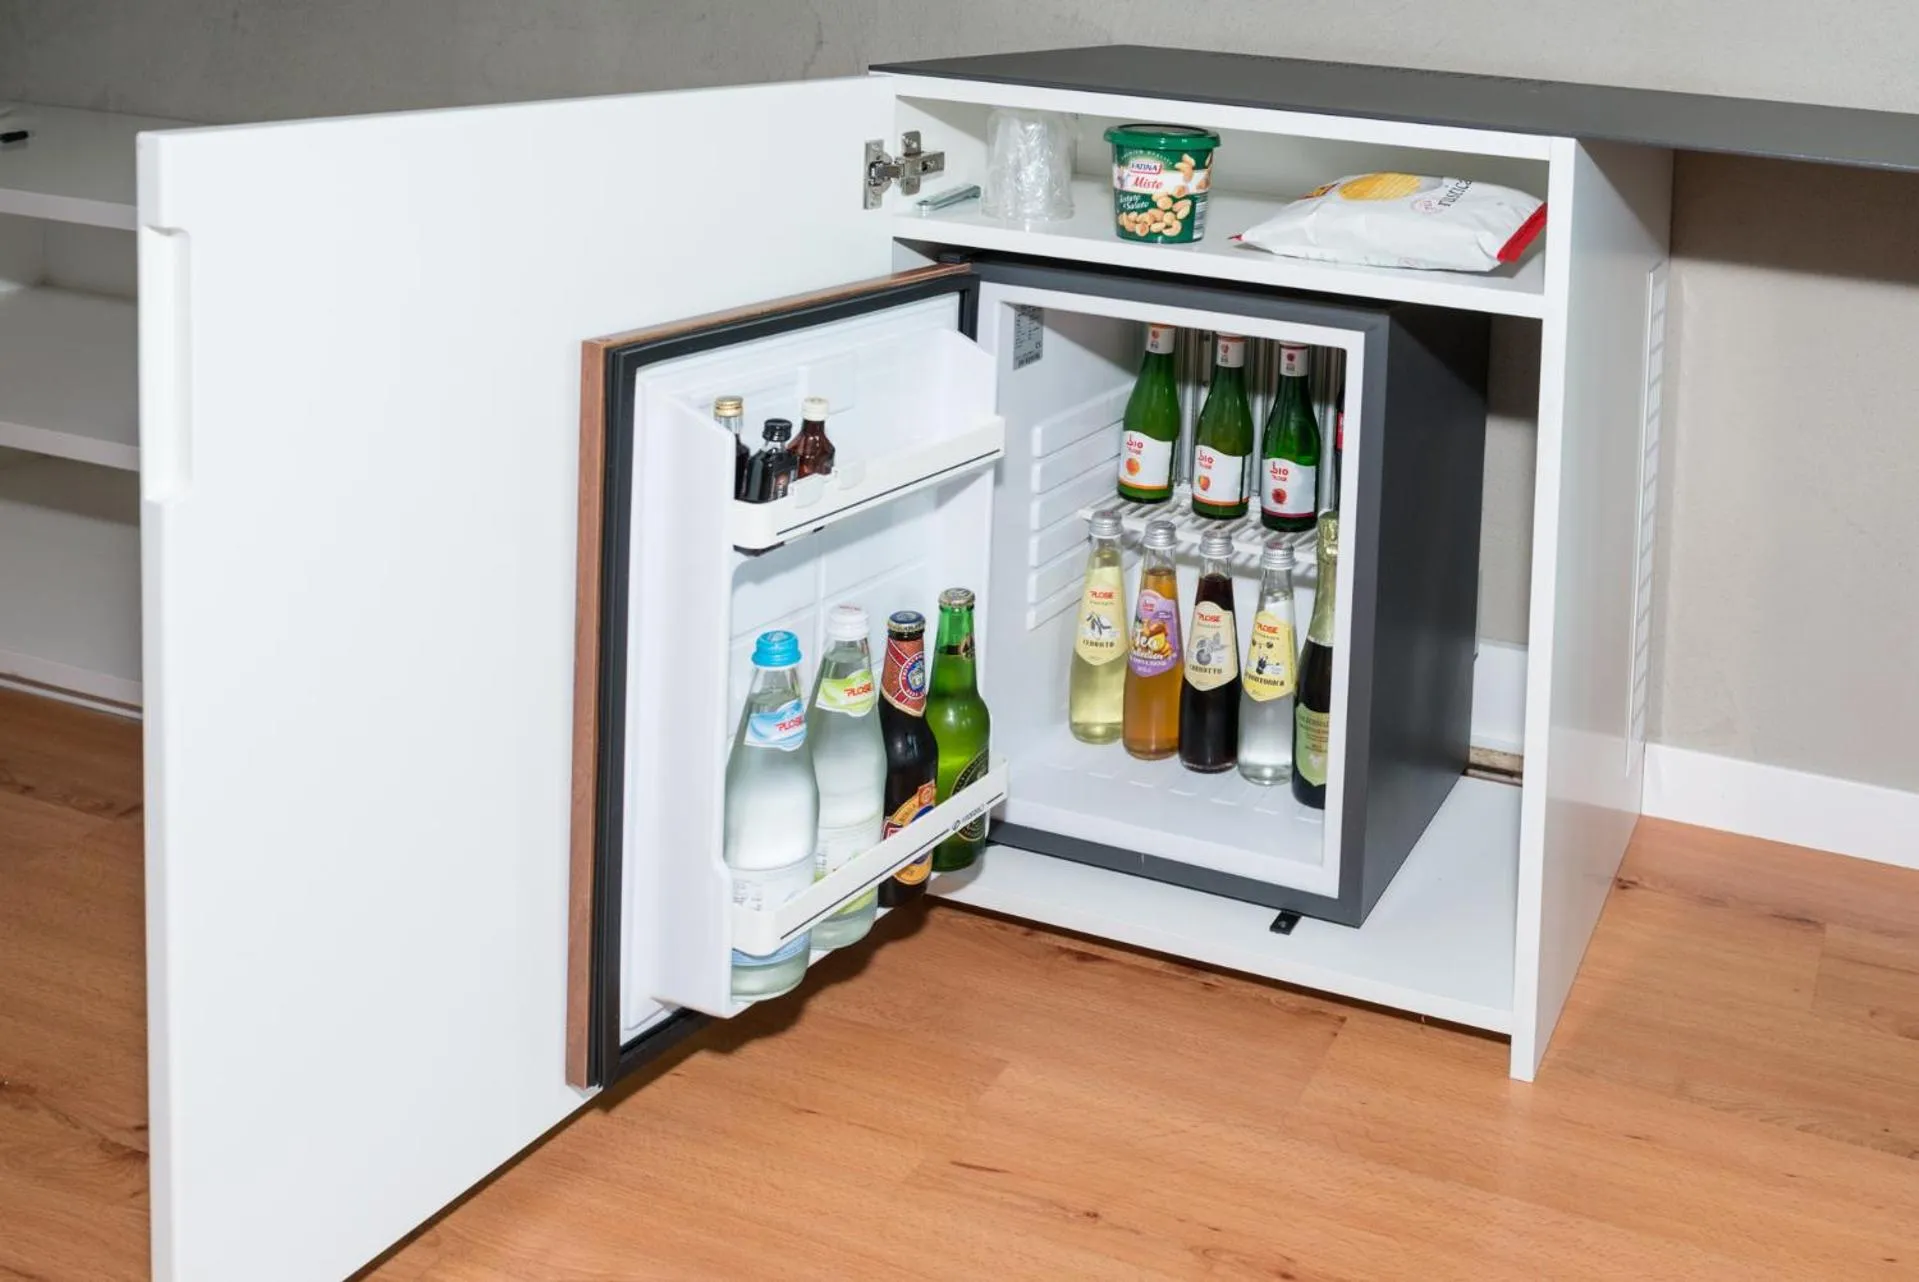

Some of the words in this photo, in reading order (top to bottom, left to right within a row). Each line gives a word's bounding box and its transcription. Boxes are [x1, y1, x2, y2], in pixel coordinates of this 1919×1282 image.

[1126, 432, 1144, 449] bio
[1198, 449, 1214, 464] bio
[1269, 460, 1289, 476] bio
[1089, 590, 1114, 600] PLOSE
[1197, 612, 1223, 623] PLOSE
[1256, 622, 1279, 634] PLOSE
